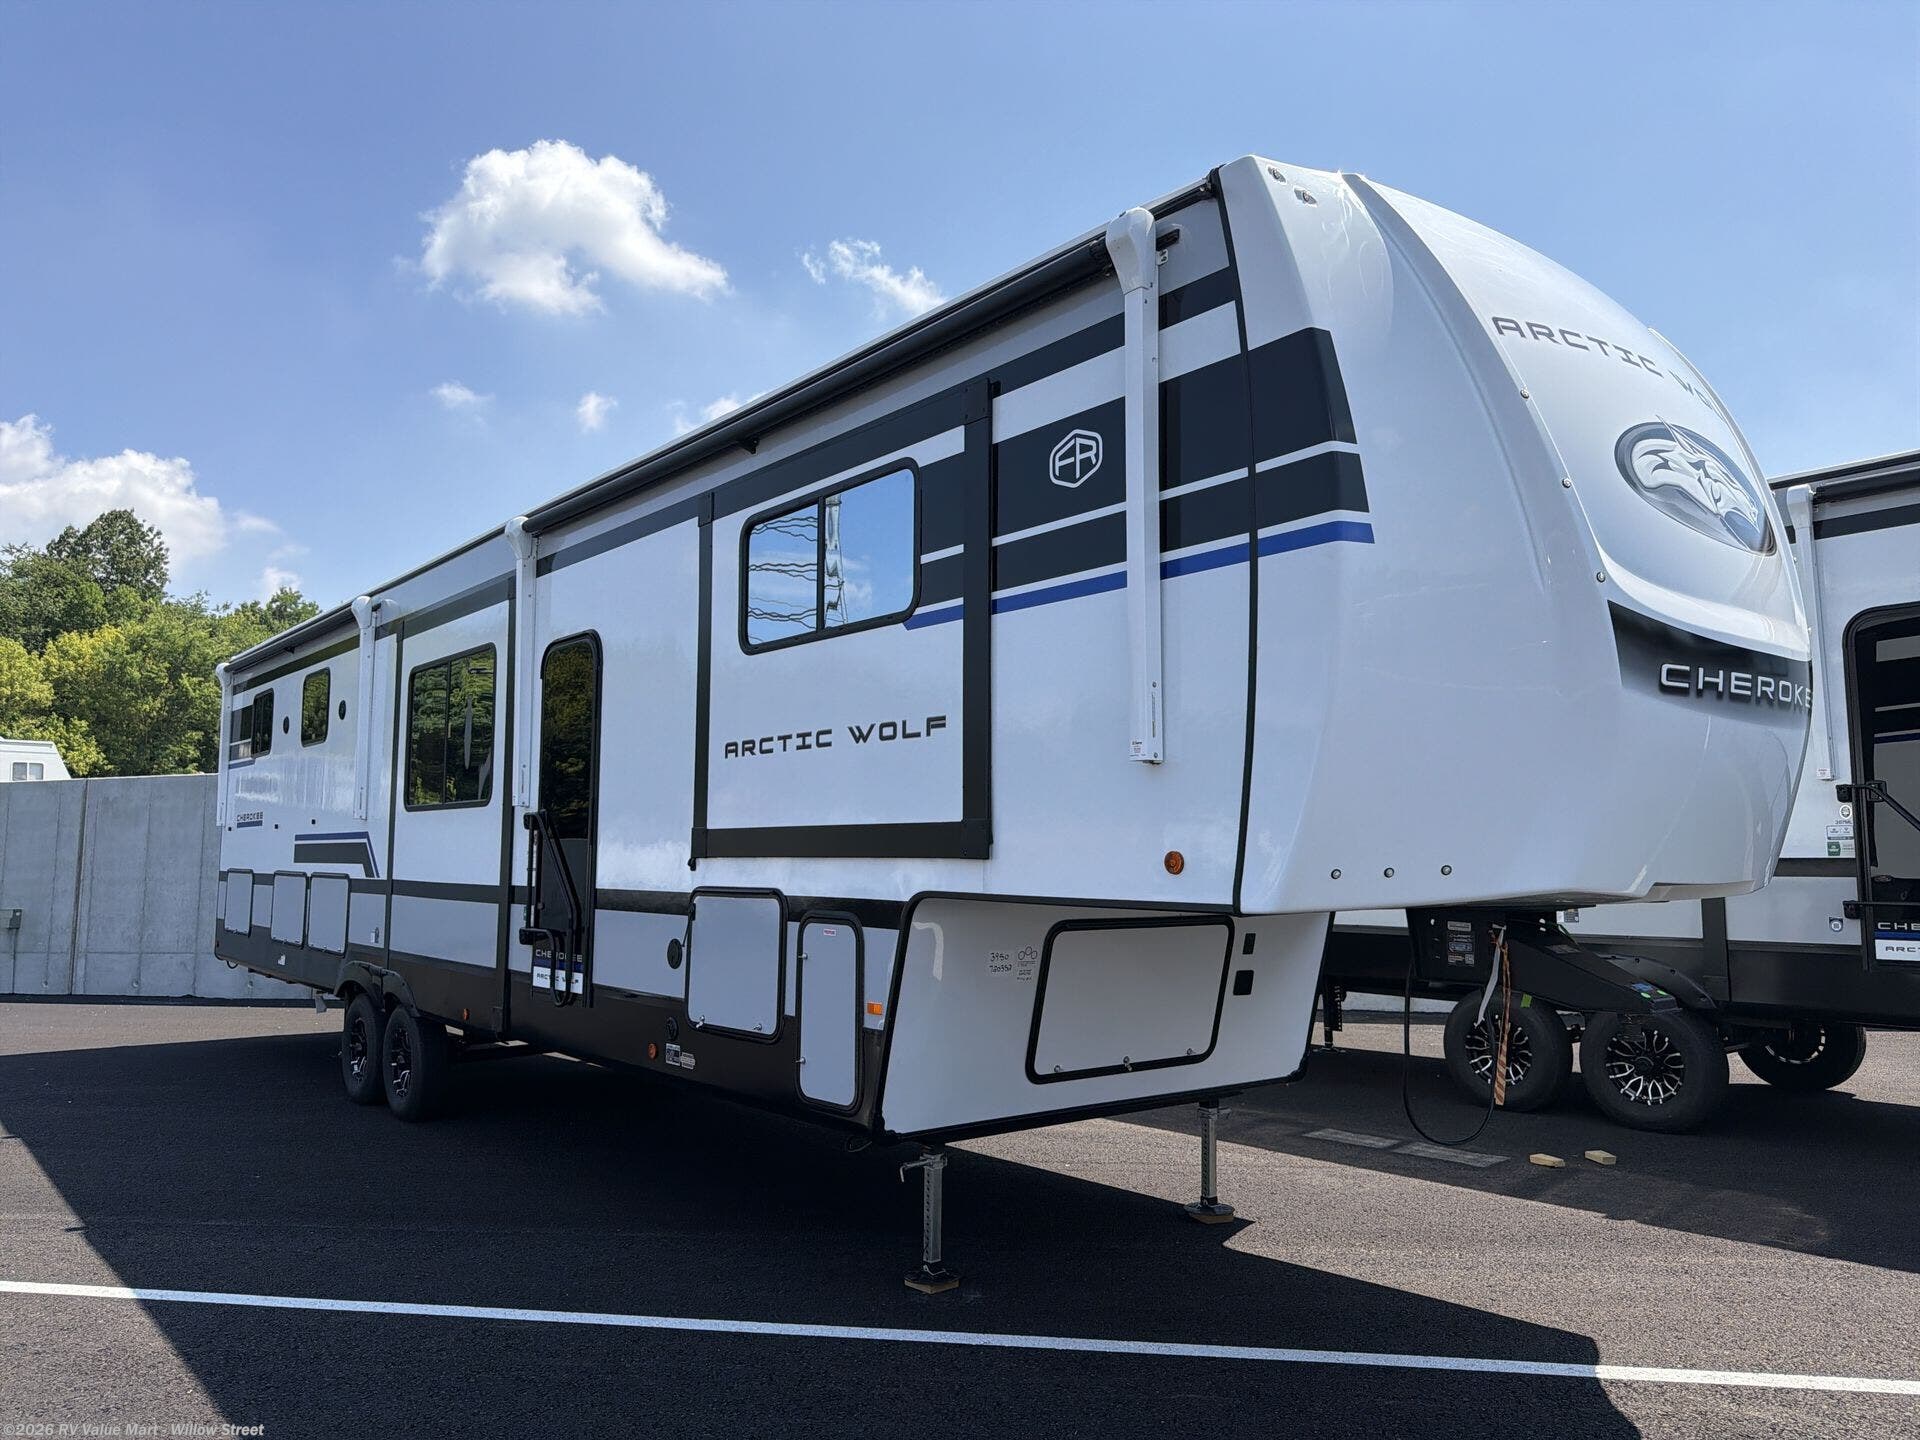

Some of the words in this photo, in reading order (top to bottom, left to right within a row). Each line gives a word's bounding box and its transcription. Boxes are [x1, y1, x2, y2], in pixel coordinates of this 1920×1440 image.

[1492, 316, 1664, 378] ARCTIC
[1668, 369, 1724, 422] WO
[725, 728, 833, 759] ARCTIC
[848, 715, 947, 744] WOLF
